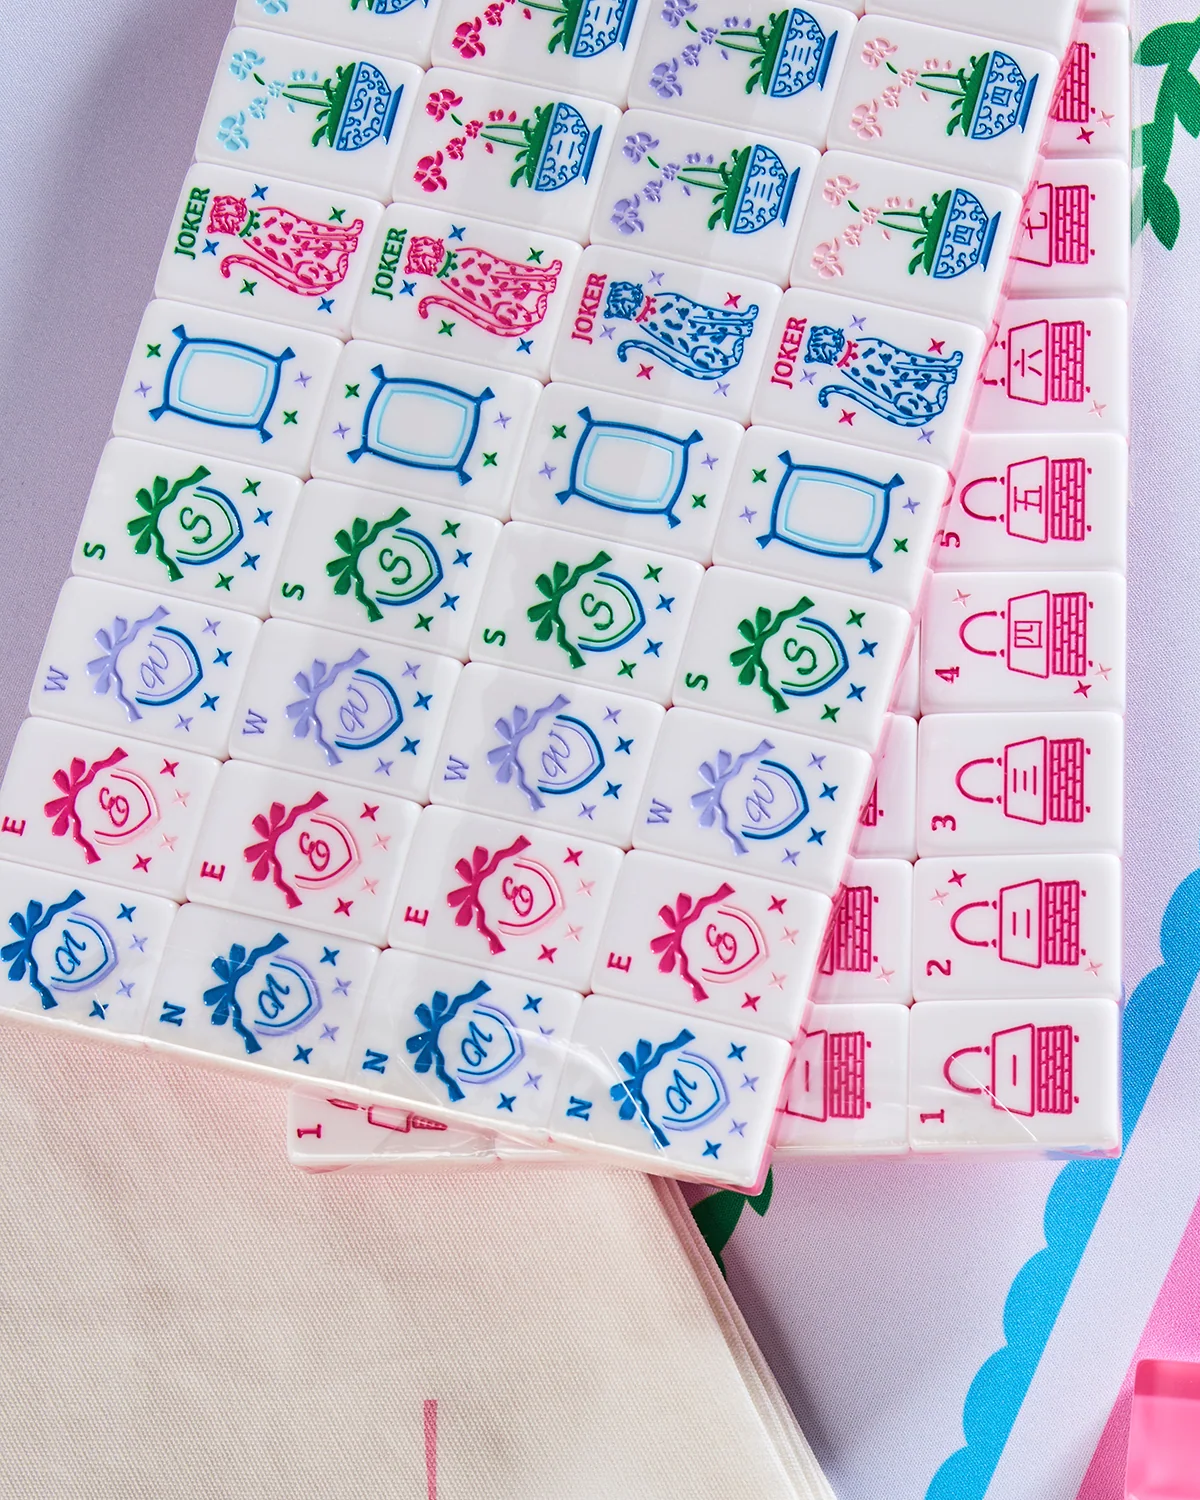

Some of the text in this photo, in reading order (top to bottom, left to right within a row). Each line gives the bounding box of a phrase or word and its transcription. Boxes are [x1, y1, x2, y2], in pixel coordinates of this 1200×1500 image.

[174, 187, 210, 260] JOKER
[371, 228, 407, 300] JOKER
[571, 273, 607, 346] JOKER
[770, 317, 807, 390] JOKER
[180, 507, 212, 544] S
[935, 529, 960, 548] 5
[83, 542, 105, 560] S
[378, 548, 412, 585] S
[282, 583, 304, 600] S
[580, 593, 614, 631] S
[483, 629, 506, 646] S
[783, 638, 817, 675] S
[44, 666, 68, 691] W
[685, 673, 708, 691] S
[935, 666, 960, 683] 4
[242, 709, 267, 734] W
[444, 755, 469, 781] W
[647, 798, 672, 824] W
[931, 815, 956, 831] 3
[1, 816, 26, 836] E
[200, 861, 226, 882] E
[404, 906, 429, 926] E
[607, 952, 632, 973] E
[926, 960, 951, 976] 2
[160, 1002, 186, 1026] N
[362, 1049, 388, 1074] N
[566, 1096, 592, 1121] N
[920, 1109, 945, 1123] 1
[297, 1124, 322, 1139] 1
